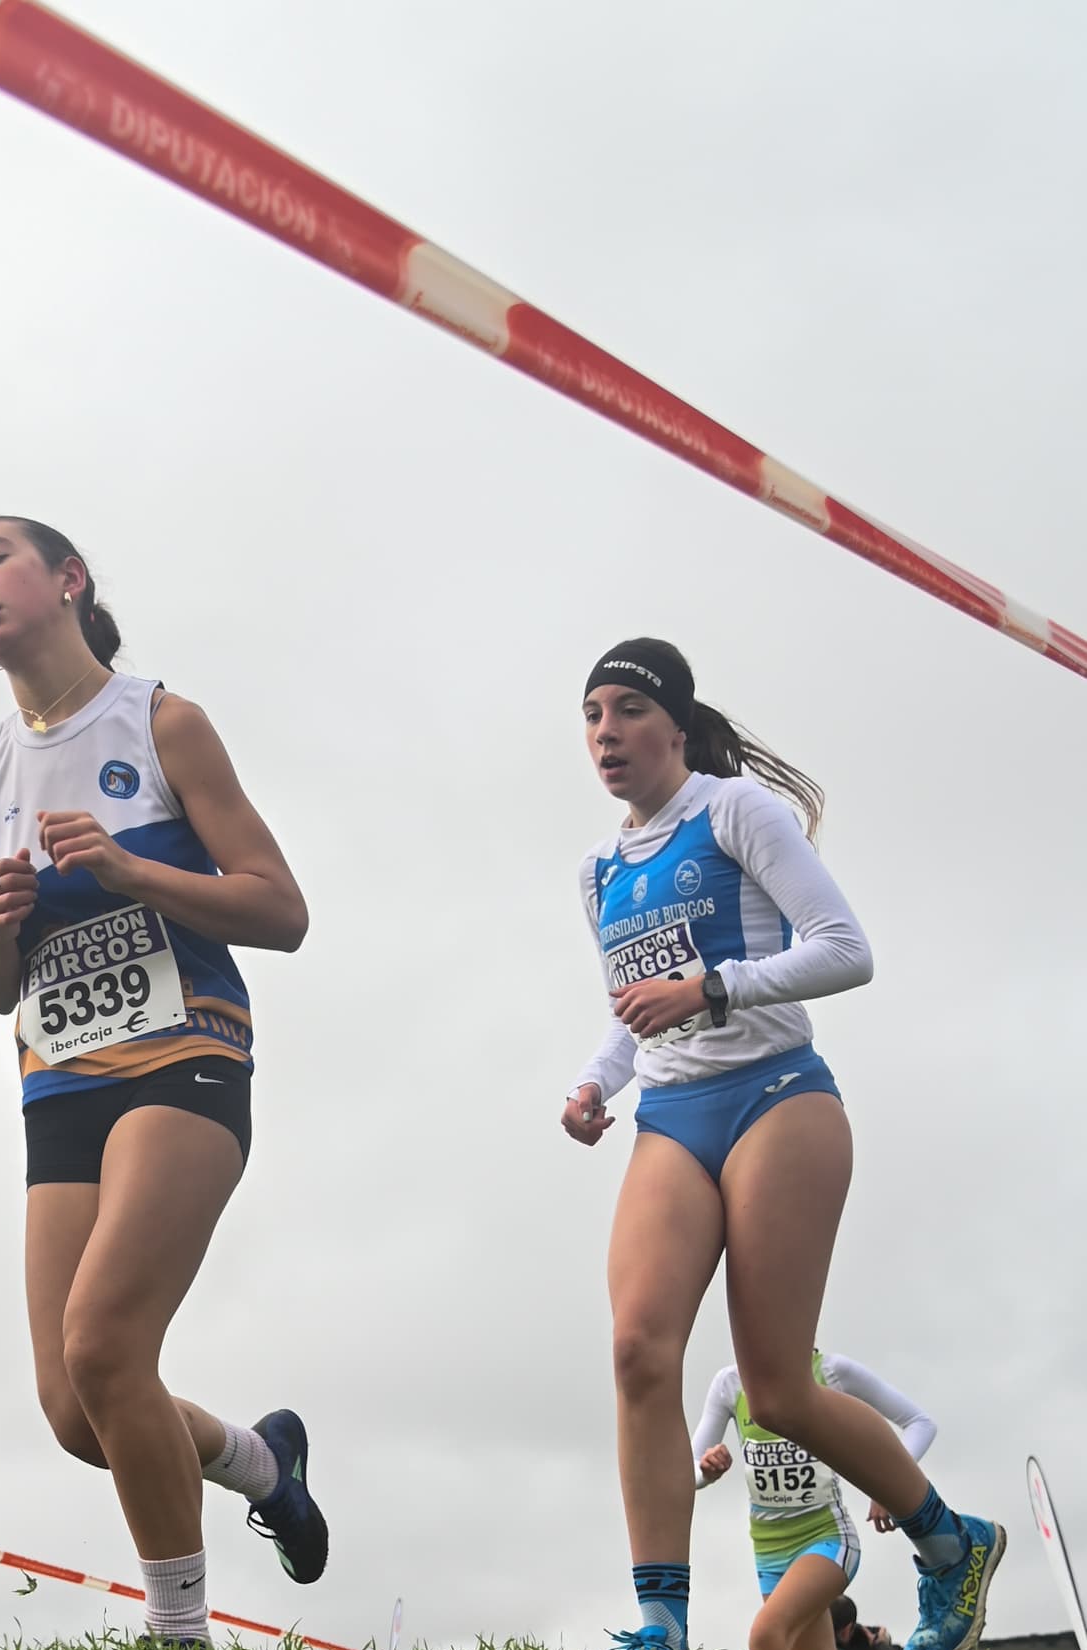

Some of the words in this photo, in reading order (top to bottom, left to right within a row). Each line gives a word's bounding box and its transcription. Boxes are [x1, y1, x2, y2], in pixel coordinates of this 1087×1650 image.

[646, 909, 662, 928] DE
[662, 897, 715, 924] BURGOS
[28, 930, 153, 995] BURGOS
[30, 910, 147, 970] DIPUTACIÓN
[39, 964, 151, 1035] 5339
[51, 1026, 113, 1054] iberCaja
[747, 1449, 818, 1466] BURGO
[754, 1465, 817, 1492] 5152
[956, 1545, 987, 1617] HOKA
